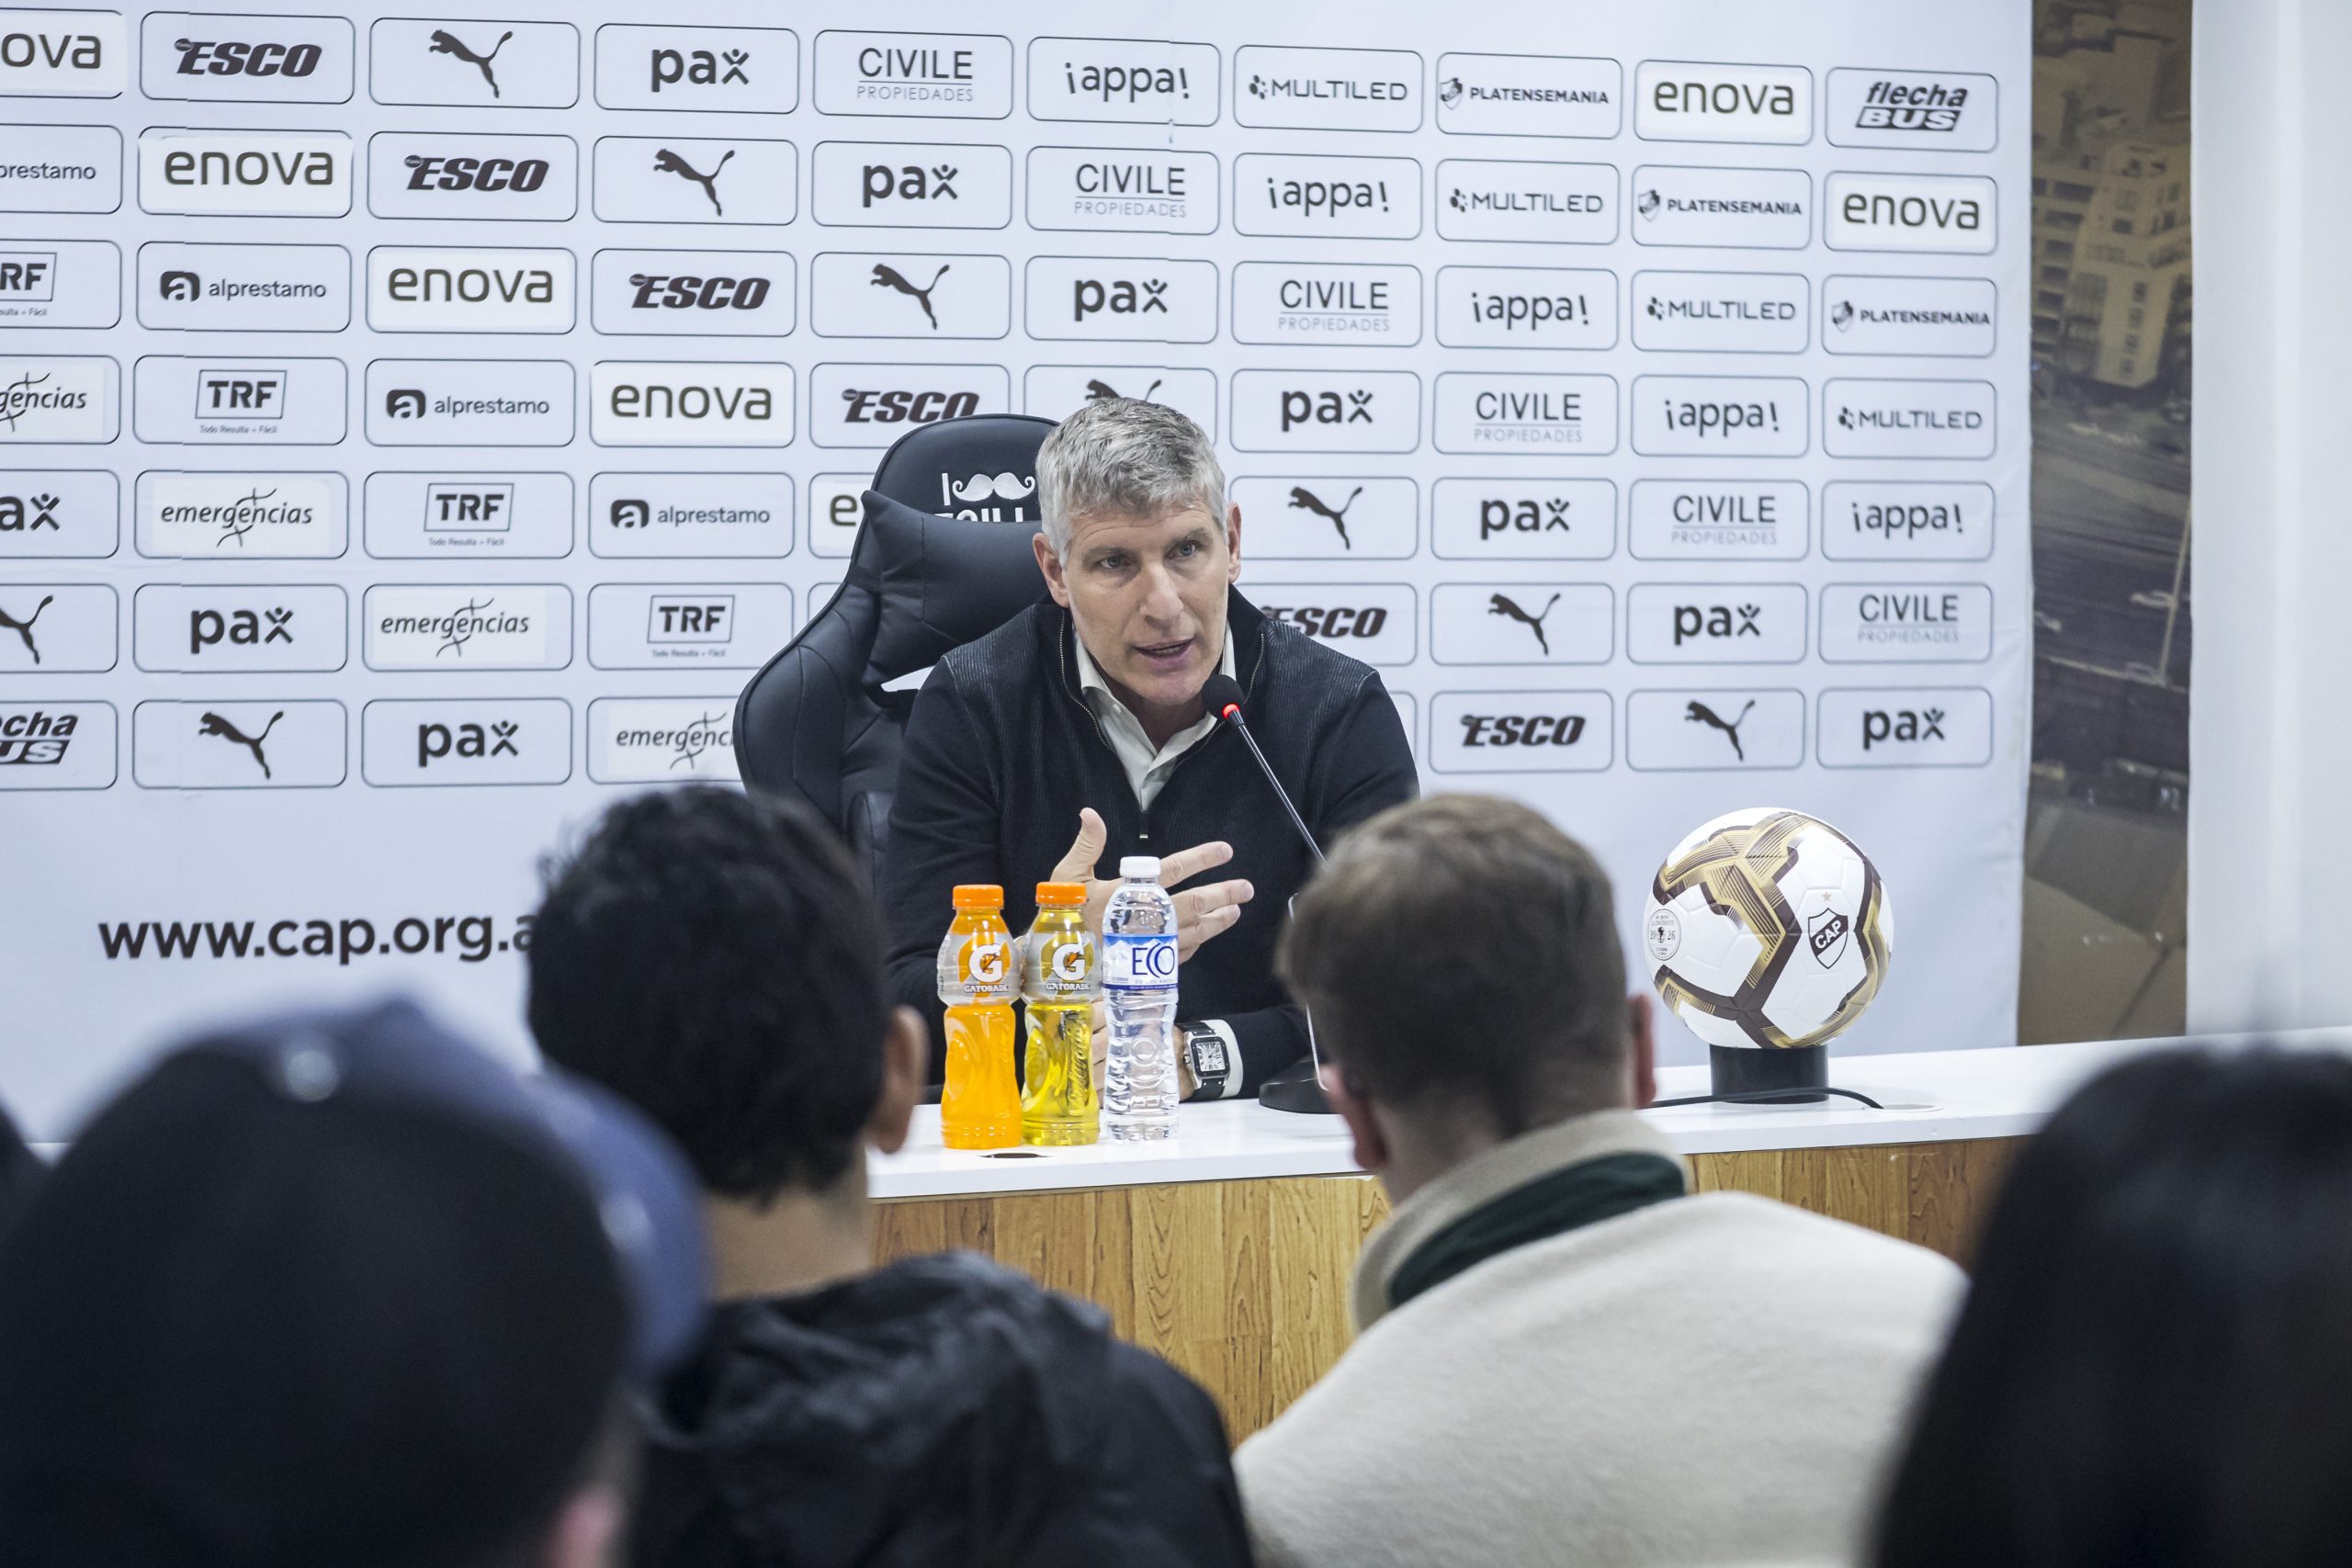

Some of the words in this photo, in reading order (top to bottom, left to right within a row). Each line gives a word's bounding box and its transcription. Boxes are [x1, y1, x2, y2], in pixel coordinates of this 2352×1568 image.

[1, 33, 101, 69] ova
[175, 39, 322, 77] ESCO
[859, 48, 972, 82] CIVILE
[651, 49, 749, 93] pax
[857, 84, 973, 101] PROPIEDADES
[1272, 80, 1408, 100] MULTILED
[1470, 87, 1609, 103] PLATENSEMANIA
[1654, 82, 1793, 115] enova
[1863, 82, 1968, 109] flecha
[1856, 107, 1961, 131] BUS
[164, 152, 333, 185] enova
[404, 155, 549, 192] ESCO
[1076, 164, 1185, 197] CIVILE
[863, 164, 958, 208] pax
[1074, 199, 1186, 218] PROPIEDADES
[1473, 193, 1603, 212] MULTILED
[1668, 199, 1802, 214] PLATENSEMANIA
[1844, 194, 1979, 230] enova
[0, 263, 47, 290] RF
[209, 279, 326, 300] alprestamo
[389, 268, 552, 303] enova
[630, 274, 771, 310] ESCO
[1075, 279, 1168, 321] pax
[1280, 280, 1388, 310] CIVILE
[1279, 315, 1389, 332] PROPIEDADES
[1668, 301, 1795, 320] MULTILED
[1860, 310, 1990, 324] PLATENSEMANIA
[207, 380, 277, 408] TRF
[435, 396, 549, 418] alprestamo
[611, 385, 772, 420] enova
[844, 389, 980, 423] ESCO
[1476, 392, 1580, 421] CIVILE
[1282, 389, 1373, 432] pax
[1860, 411, 1983, 429] MULTILED
[1474, 425, 1582, 443] PROPIEDADES
[161, 502, 312, 527] emergencias
[435, 494, 504, 521] TRF
[658, 506, 770, 527] alprestamo
[1481, 498, 1569, 540] pax
[1673, 495, 1775, 523] CIVILE
[1671, 528, 1777, 545] PROPIEDADES
[659, 605, 726, 632] TRF
[1860, 594, 1958, 622] CIVILE
[191, 607, 293, 654] pax
[380, 614, 530, 637] emergencias
[1674, 604, 1760, 646] pax
[1858, 626, 1960, 643] PROPIEDADES
[0, 711, 78, 737] cha
[1461, 715, 1586, 747] ESCO
[1863, 708, 1944, 750] pax
[419, 721, 518, 768] pax
[1815, 920, 1842, 949] CAP
[969, 943, 1003, 983] G
[1052, 943, 1086, 981] G
[963, 984, 1010, 993] GATORADE
[1046, 983, 1091, 991] GATORADE
